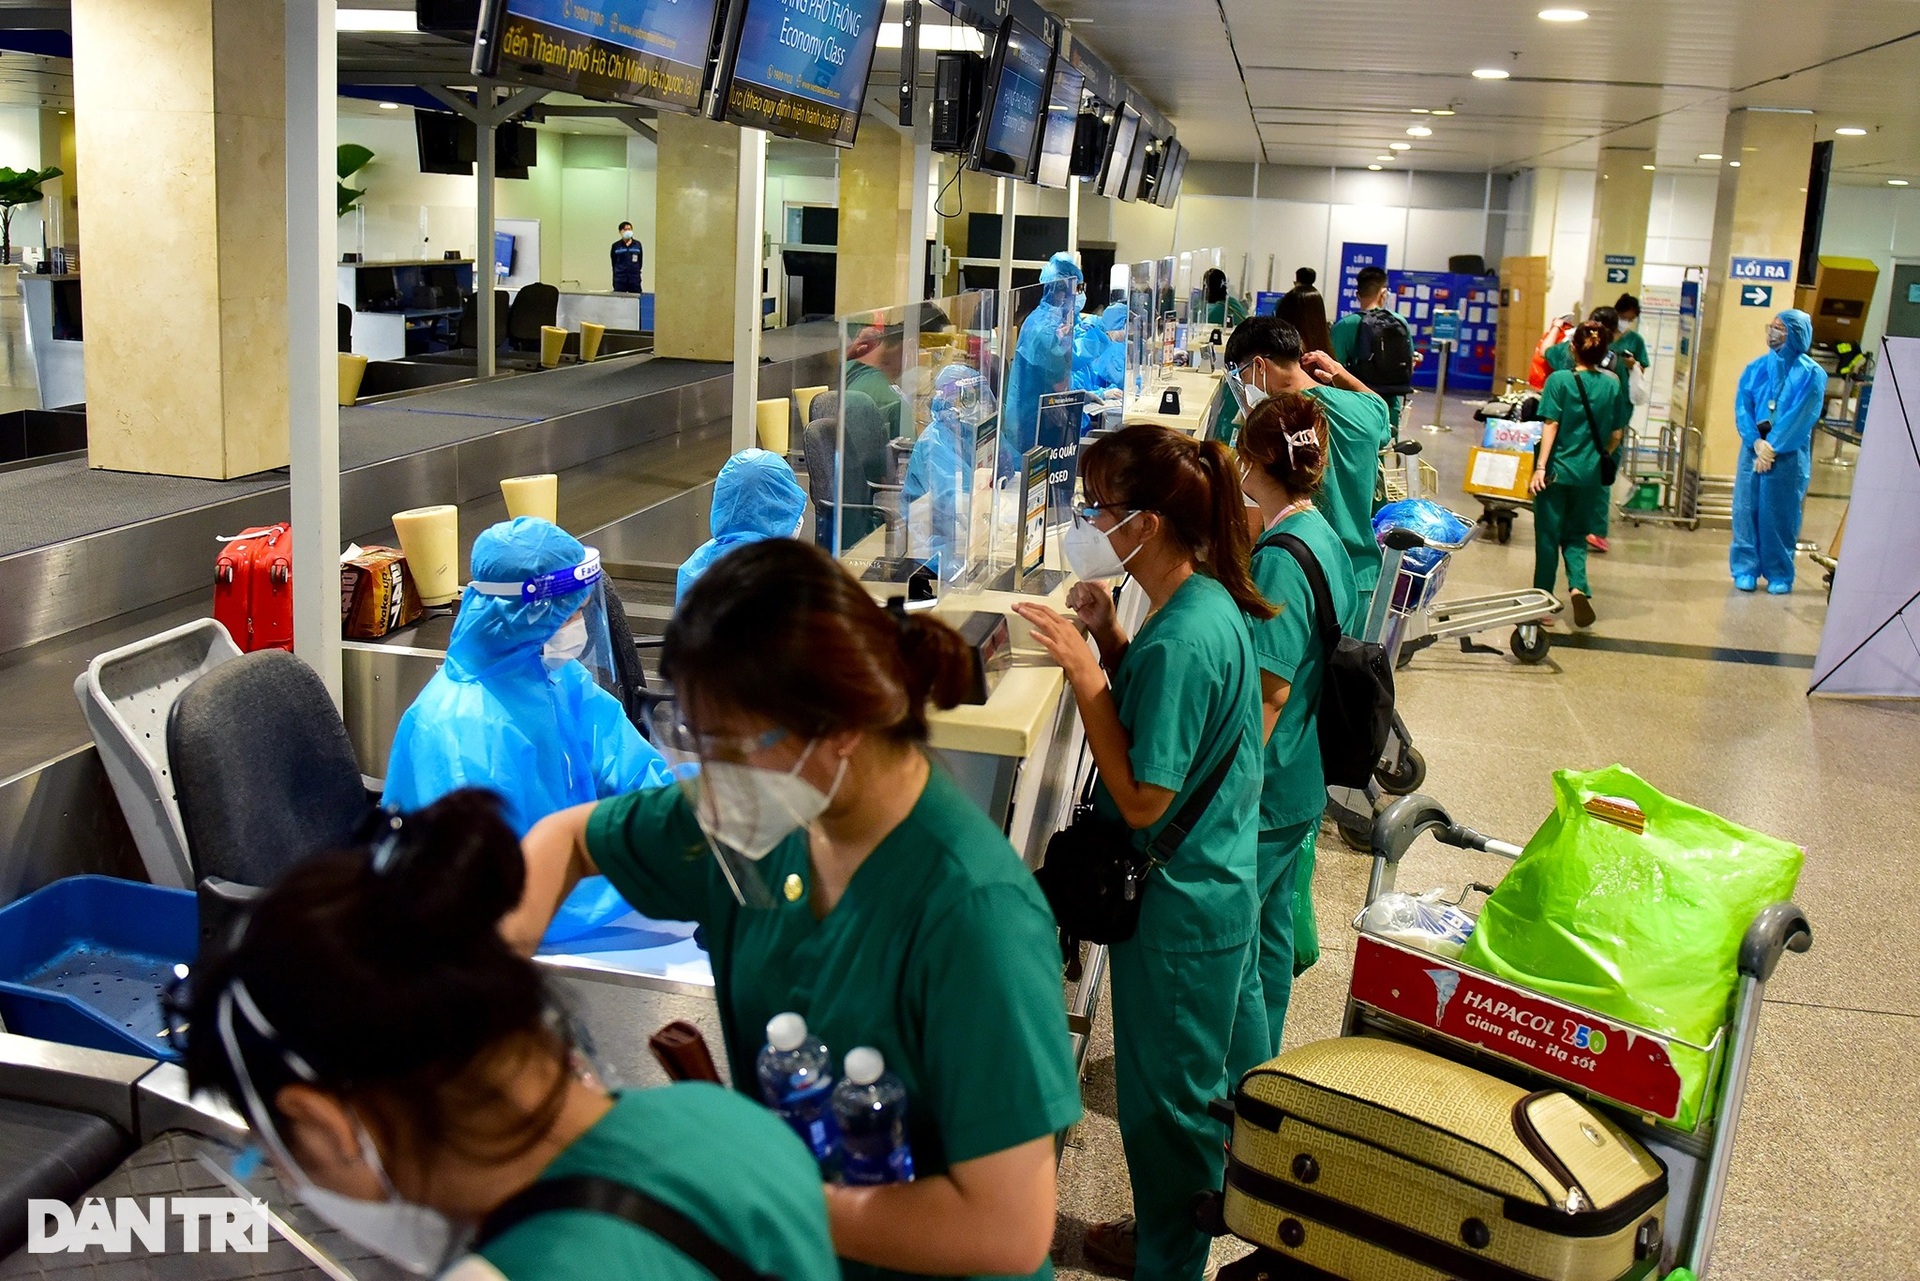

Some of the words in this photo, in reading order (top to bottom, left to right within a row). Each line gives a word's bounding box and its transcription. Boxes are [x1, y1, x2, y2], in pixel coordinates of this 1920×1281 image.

[779, 16, 824, 63] Economy
[824, 36, 846, 66] Class
[830, 2, 862, 38] THÔNG
[503, 25, 528, 57] đến
[532, 32, 567, 67] Thành
[568, 44, 593, 74] phố
[591, 48, 608, 76] Hồ
[607, 54, 625, 79] Chí
[625, 58, 648, 86] Minh
[648, 67, 659, 88] và
[658, 74, 685, 97] ngược
[742, 87, 762, 112] (theo
[762, 98, 777, 119] quy
[776, 98, 792, 119] định
[791, 99, 806, 124] hiện
[805, 106, 820, 126] hành
[820, 110, 832, 127] của
[831, 113, 840, 133] Bộ
[1736, 260, 1761, 276] LỐI
[1764, 267, 1785, 278] RA
[1050, 469, 1068, 484] OSED
[1462, 990, 1556, 1037] HAPACOL
[1561, 1018, 1607, 1055] 250
[1465, 1012, 1504, 1037] Giảm
[1507, 1028, 1537, 1050] đau
[1545, 1042, 1568, 1063] Hạ
[1570, 1049, 1597, 1072] sốt
